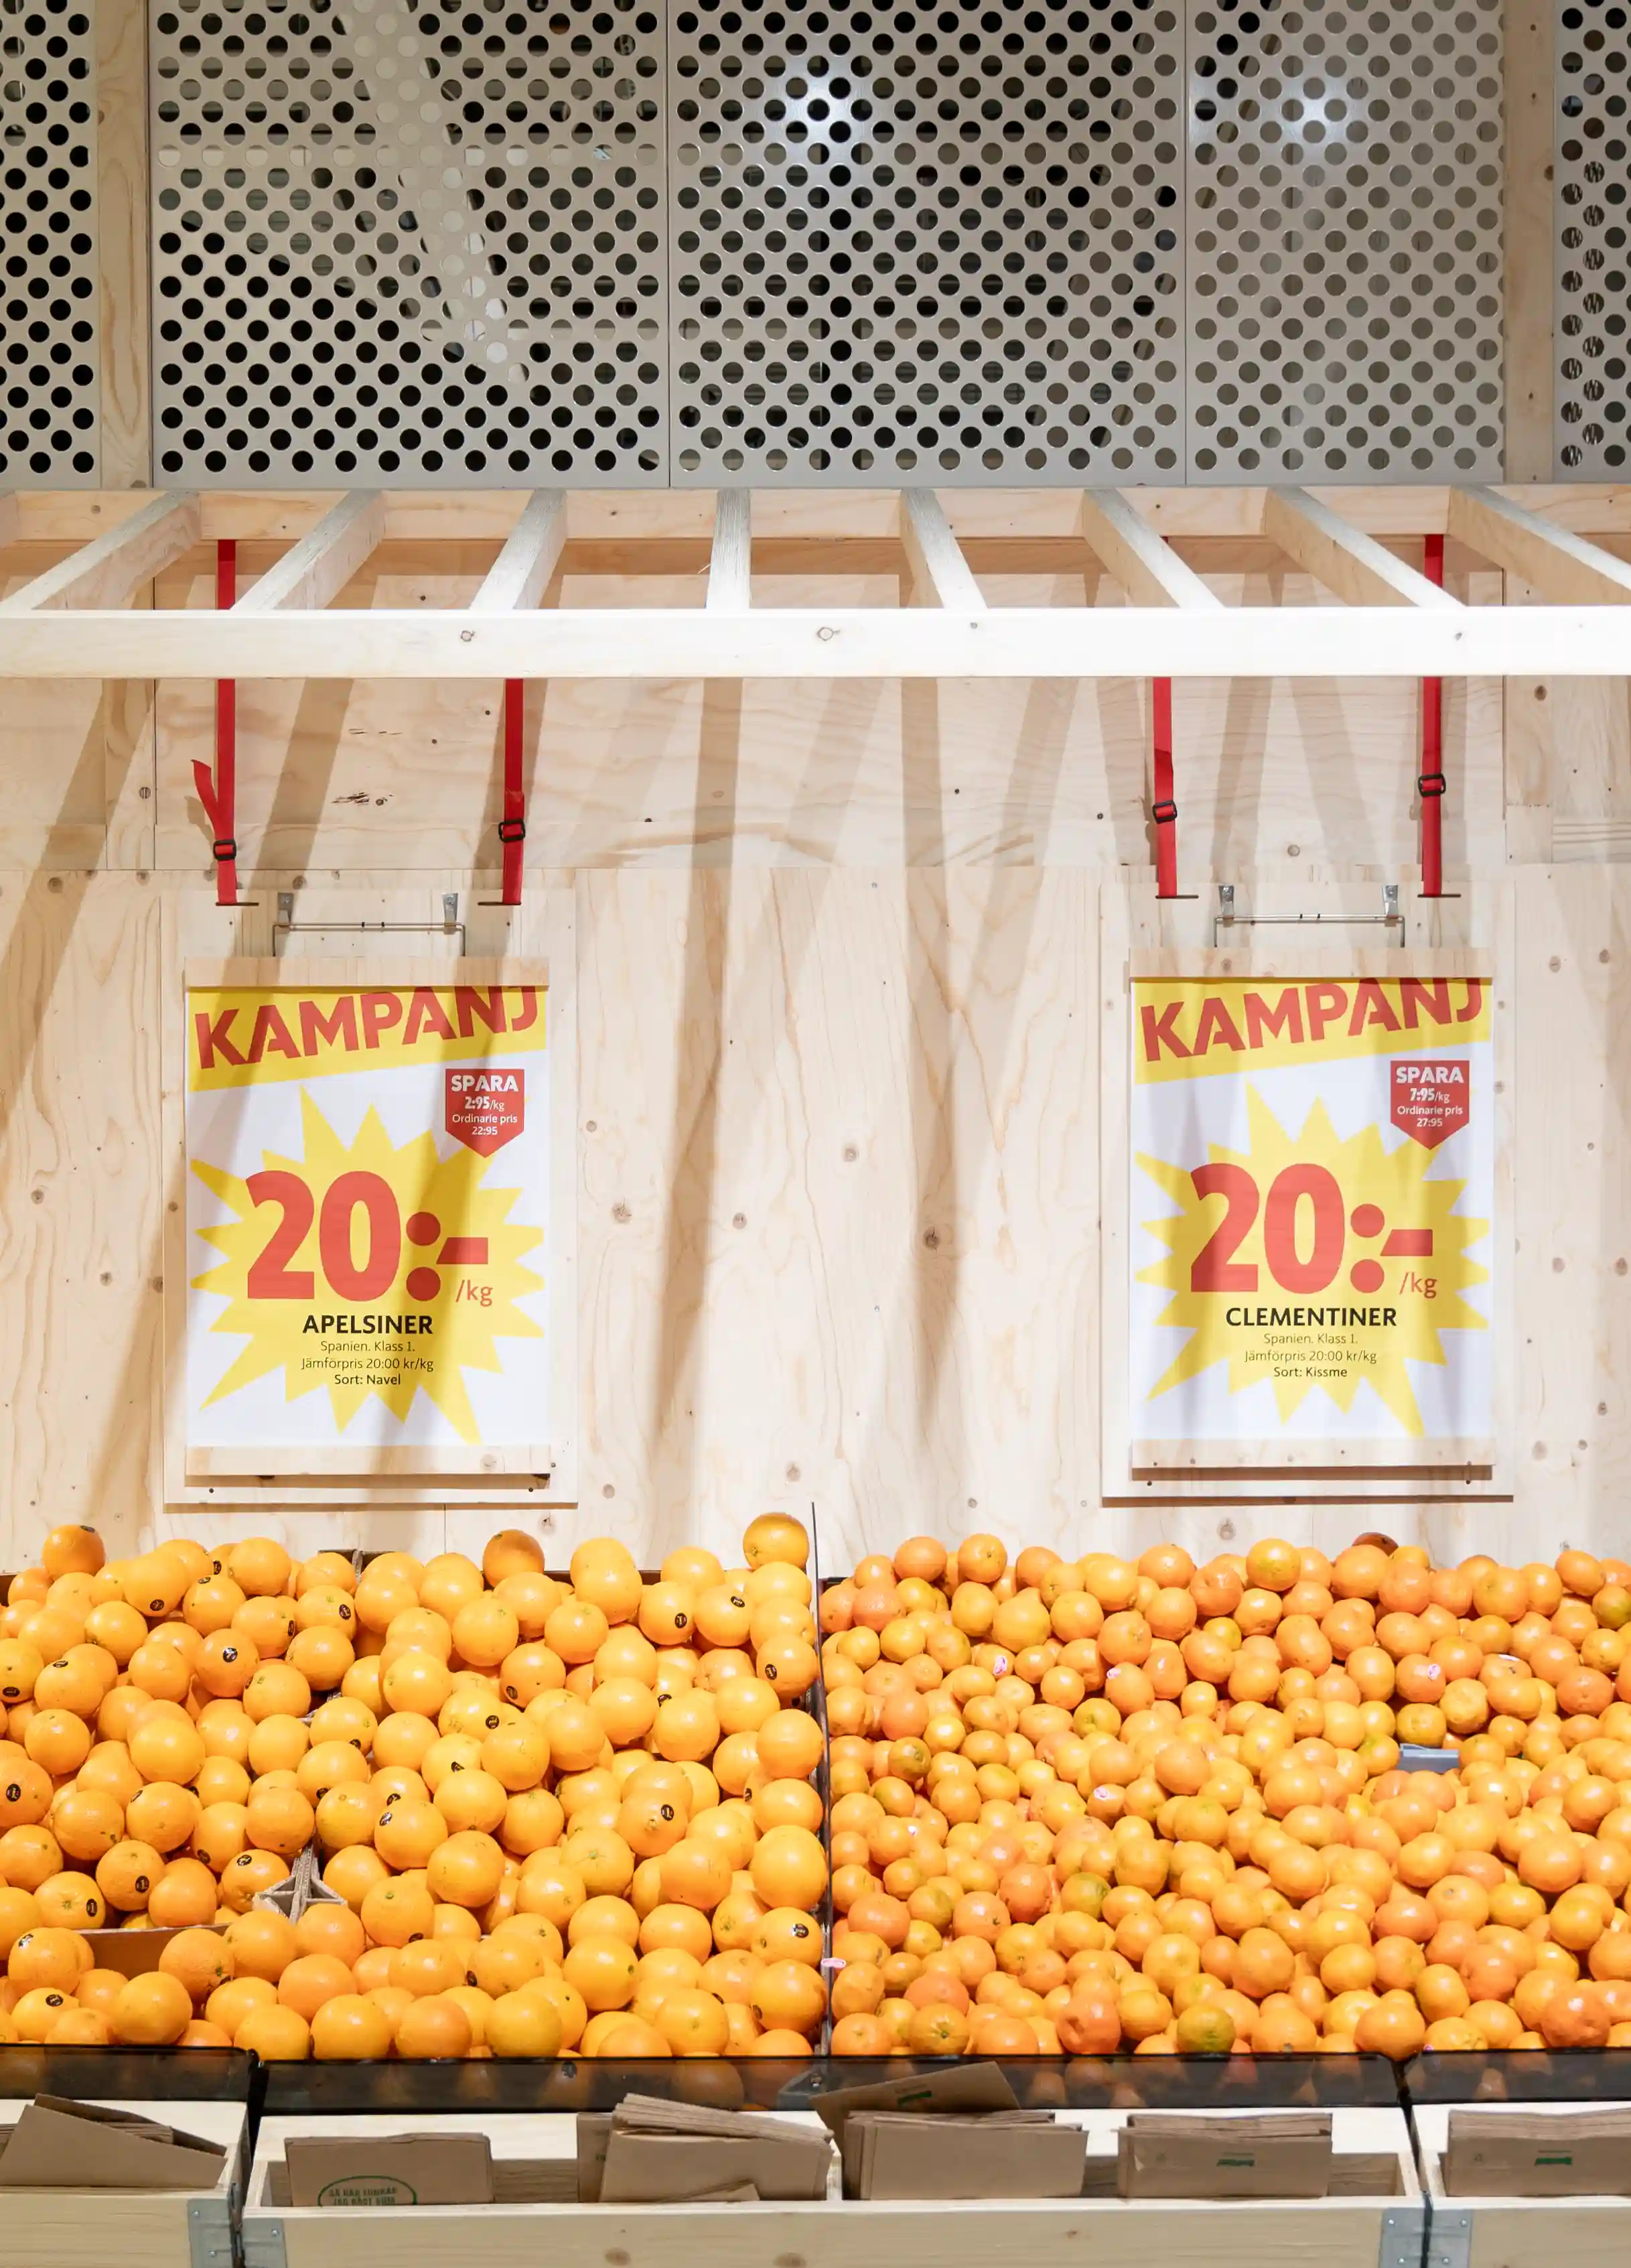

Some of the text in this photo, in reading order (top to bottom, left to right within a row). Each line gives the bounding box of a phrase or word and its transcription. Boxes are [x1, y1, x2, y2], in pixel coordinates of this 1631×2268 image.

[1141, 978, 1482, 1062] KAMPANJ
[195, 986, 538, 1069] KAMPANJ
[1396, 1066, 1464, 1083] SPARA
[451, 1075, 519, 1091] SPARA
[1397, 1106, 1463, 1118] Ordinarie pris
[452, 1114, 518, 1126] Ordinarie pris
[1417, 1118, 1443, 1127] 27:95
[472, 1126, 498, 1135] 22:95
[1399, 1272, 1438, 1298] /kg
[455, 1279, 493, 1307] /kg
[1226, 1307, 1397, 1327] CLEMENTINER
[302, 1315, 433, 1335] APELSINER
[1264, 1333, 1358, 1346] Spanien. Klass 1.
[321, 1341, 415, 1354] Spanien. Klass 1.
[1245, 1350, 1377, 1364] Jämförpris 20:00 kr/kg
[301, 1357, 434, 1372] Jämförpris 20:00 kr/kg
[334, 1374, 401, 1385] Sort: Navel
[1273, 1367, 1348, 1378] Sort: Kissme
